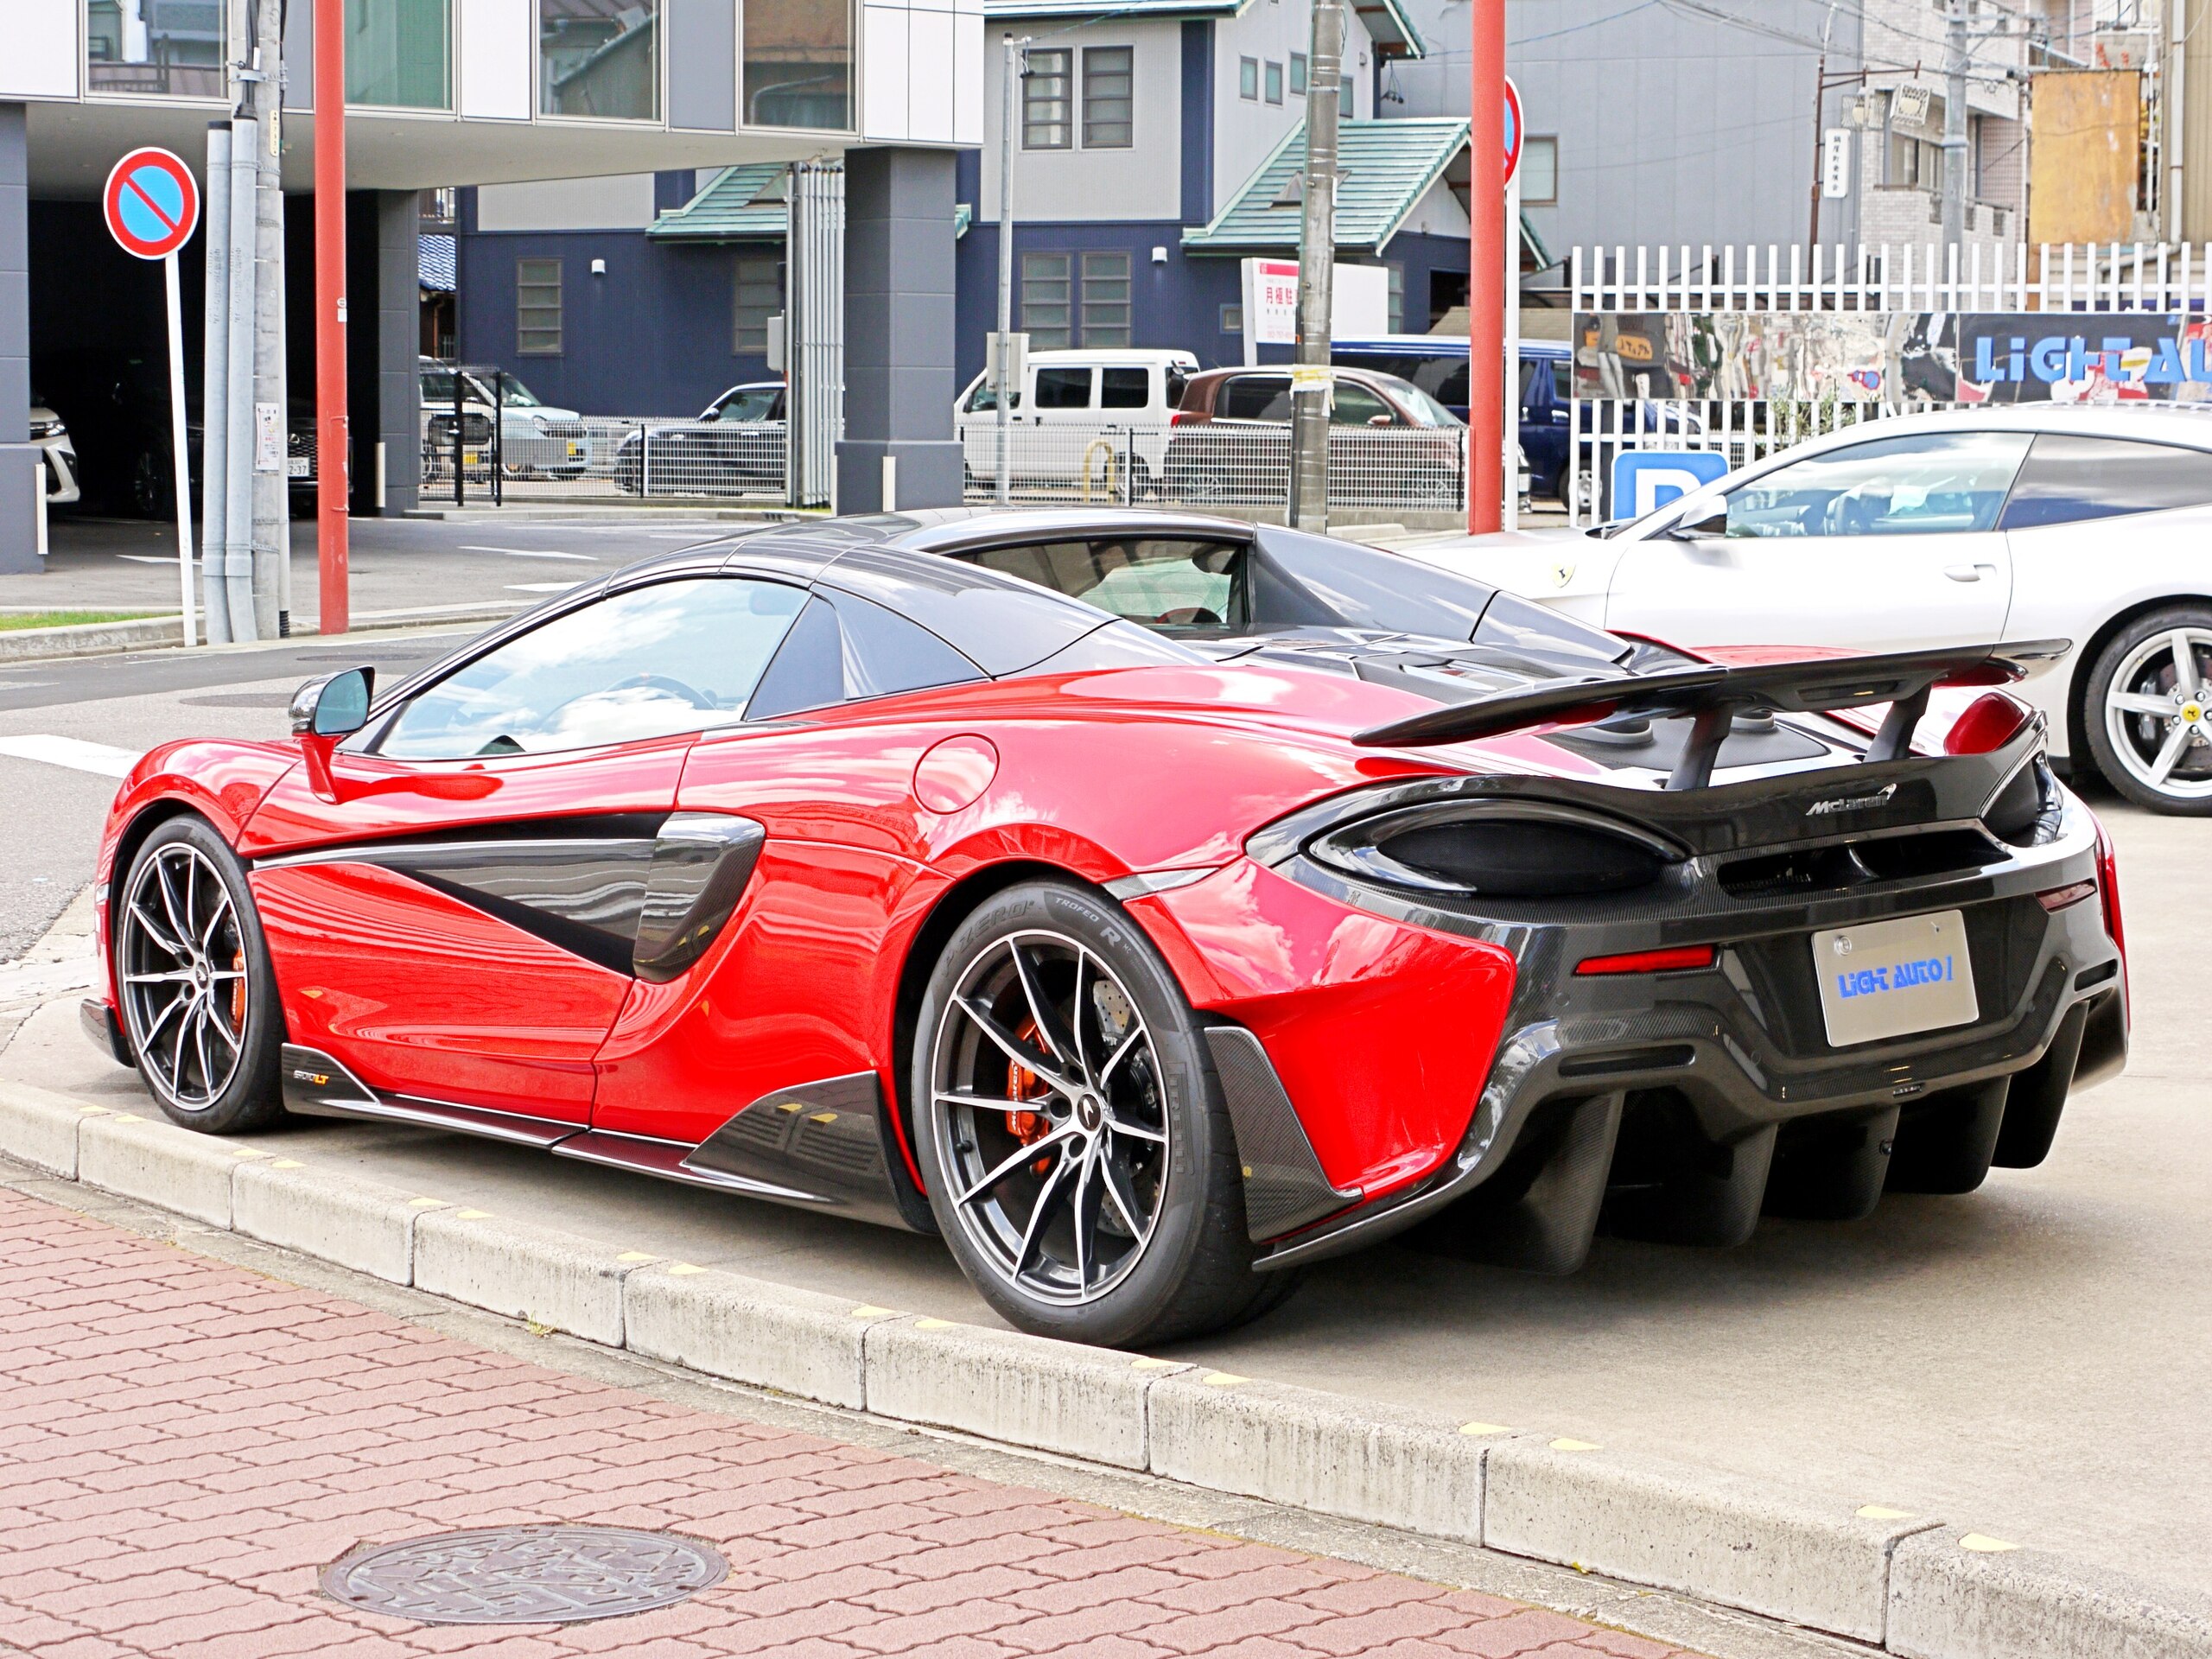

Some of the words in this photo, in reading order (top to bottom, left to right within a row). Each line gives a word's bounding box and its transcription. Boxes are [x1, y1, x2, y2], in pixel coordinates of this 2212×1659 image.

[1267, 287, 1300, 304] 月極駐
[1056, 898, 1100, 922] TROFEO
[1100, 926, 1122, 947] R
[1893, 958, 1943, 988] AUTO
